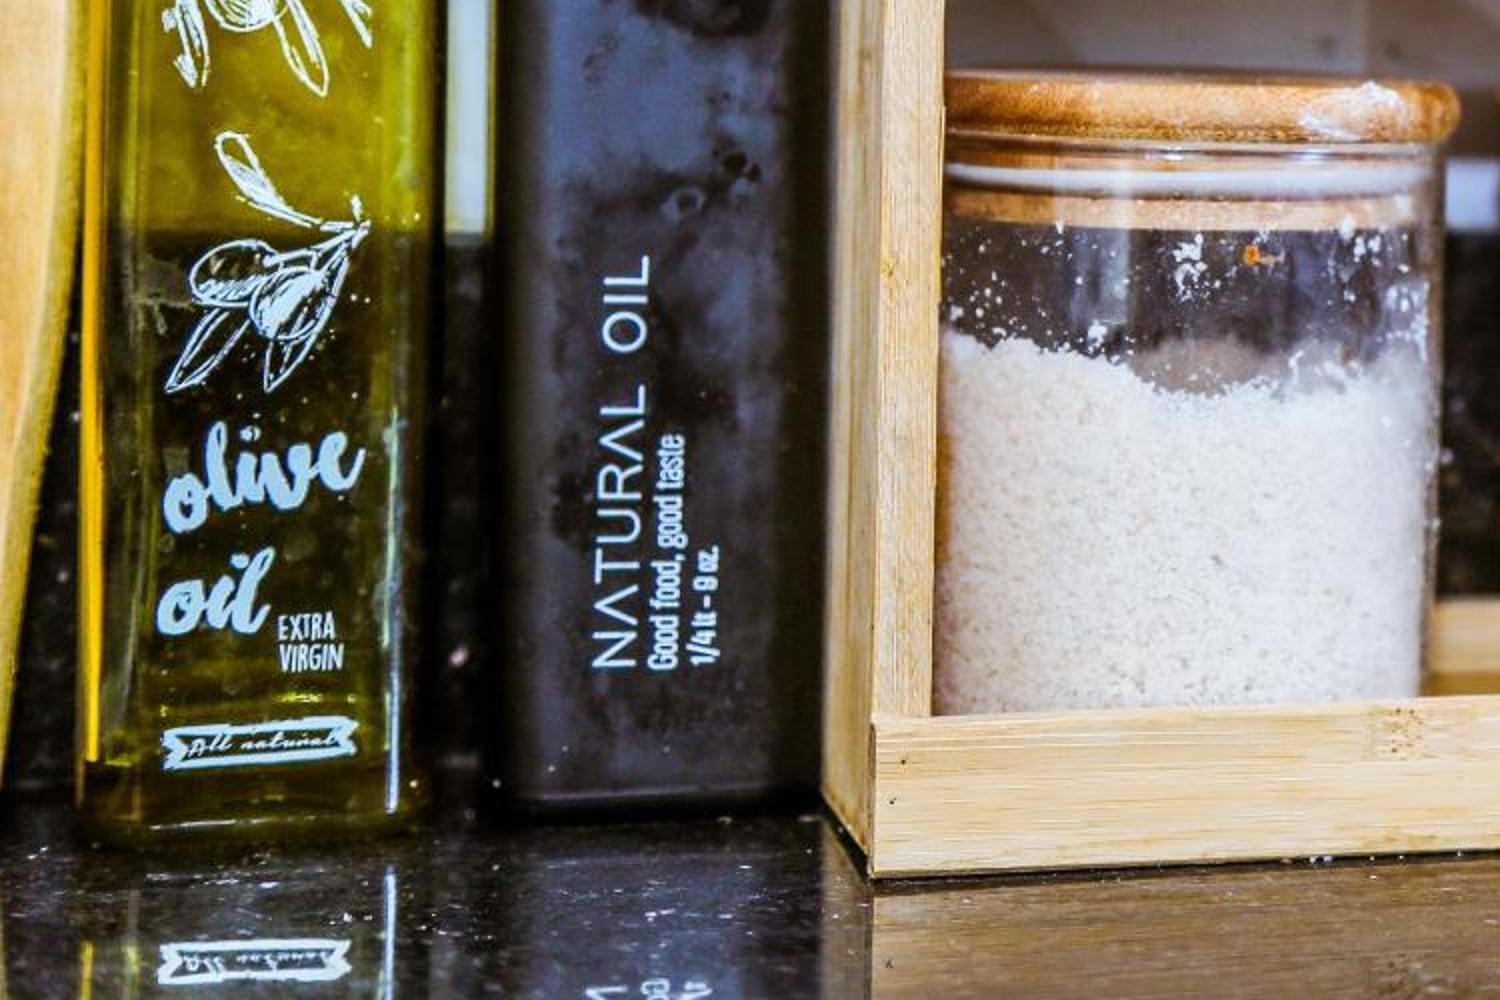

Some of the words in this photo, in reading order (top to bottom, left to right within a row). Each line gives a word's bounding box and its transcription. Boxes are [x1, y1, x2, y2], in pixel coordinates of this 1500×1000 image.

[602, 255, 650, 353] OIL
[162, 420, 366, 534] olive
[655, 433, 686, 490] taste
[592, 384, 646, 669] NATURAL
[653, 494, 689, 549] good
[649, 554, 686, 610] food,
[697, 544, 720, 573] oz.
[155, 546, 277, 637] oil
[277, 611, 336, 641] EXTRA
[646, 613, 679, 671] Good
[684, 629, 721, 666] 1/4
[278, 643, 344, 672] VIRGIN
[185, 732, 233, 759] All
